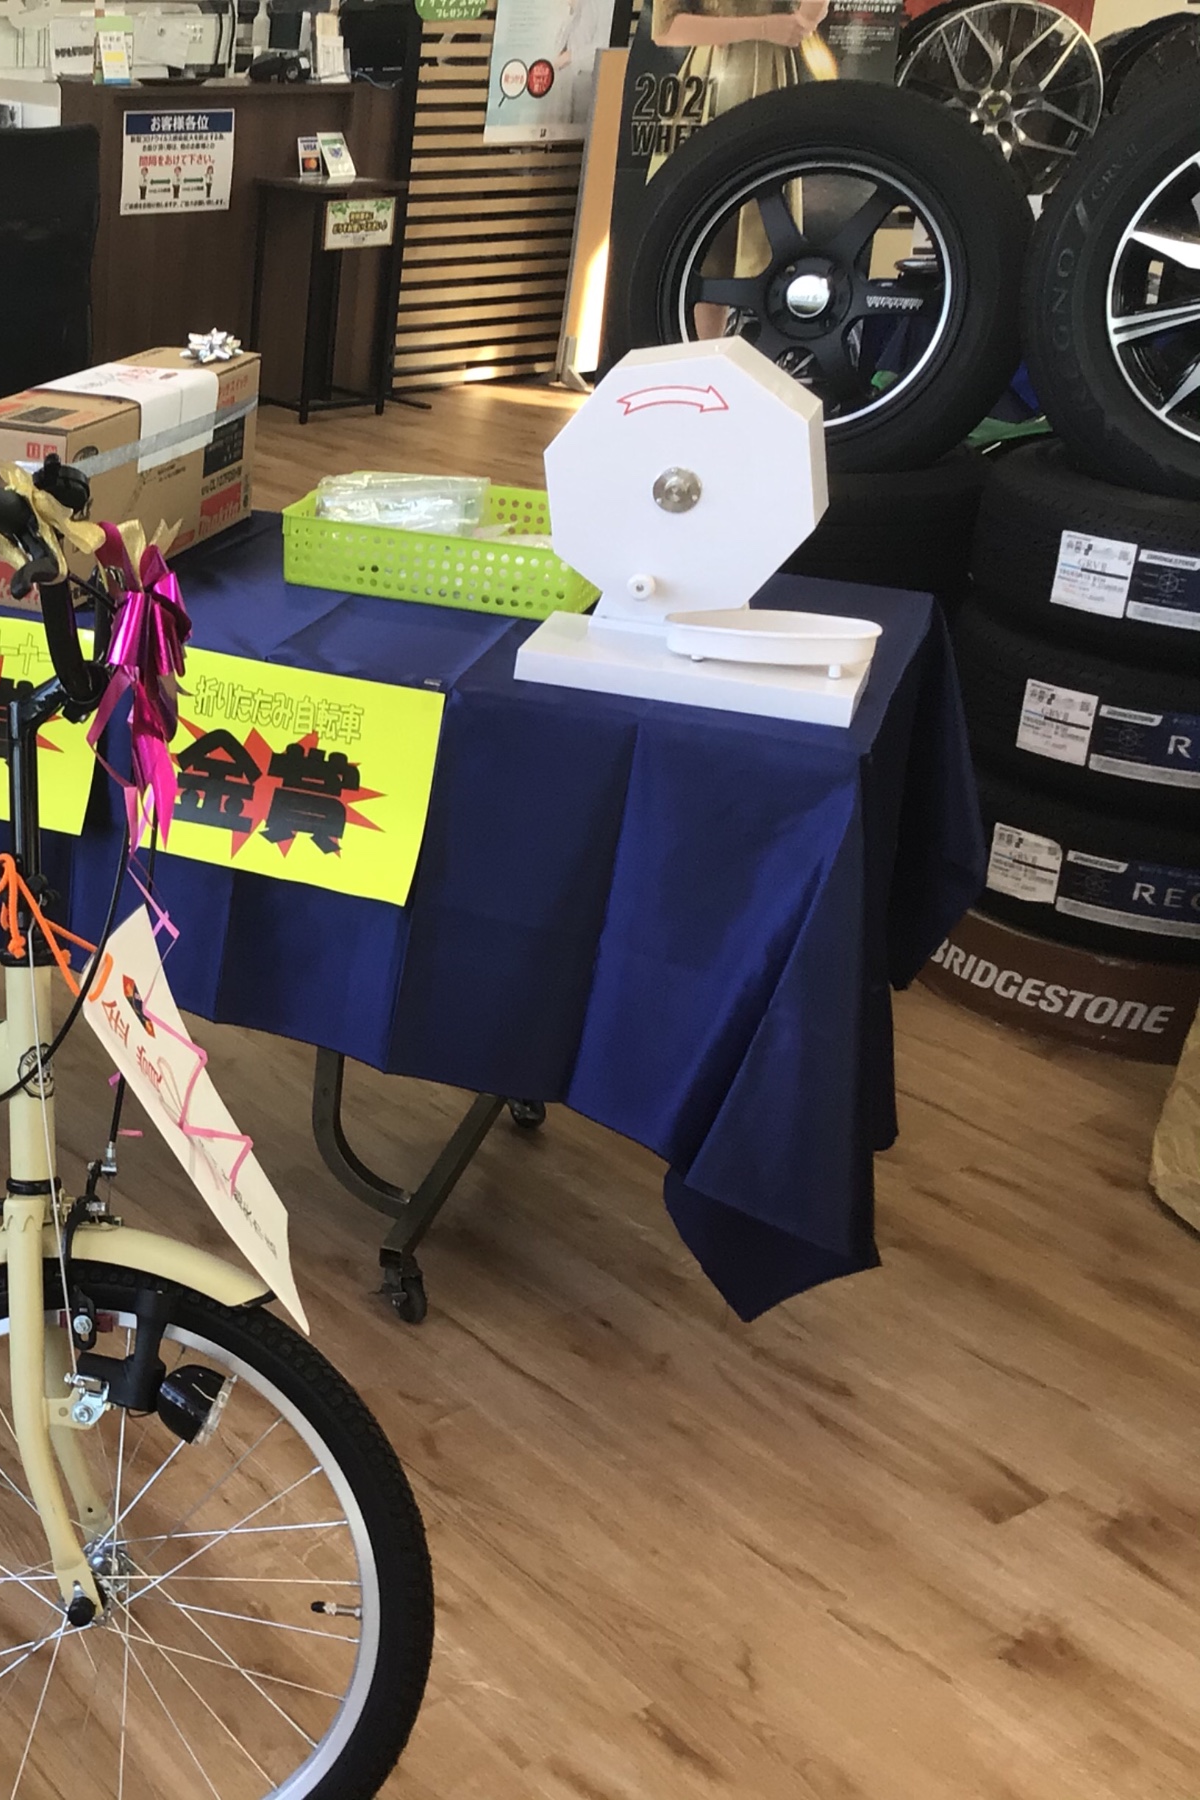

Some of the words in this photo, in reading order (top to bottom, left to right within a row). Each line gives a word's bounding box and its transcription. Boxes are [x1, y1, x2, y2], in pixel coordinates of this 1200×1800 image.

[632, 73, 717, 121] 2021
[150, 114, 210, 132] お客様各位
[631, 121, 702, 156] WHE
[194, 675, 364, 745] 折りたたみ自転車
[172, 729, 360, 855] 金賞
